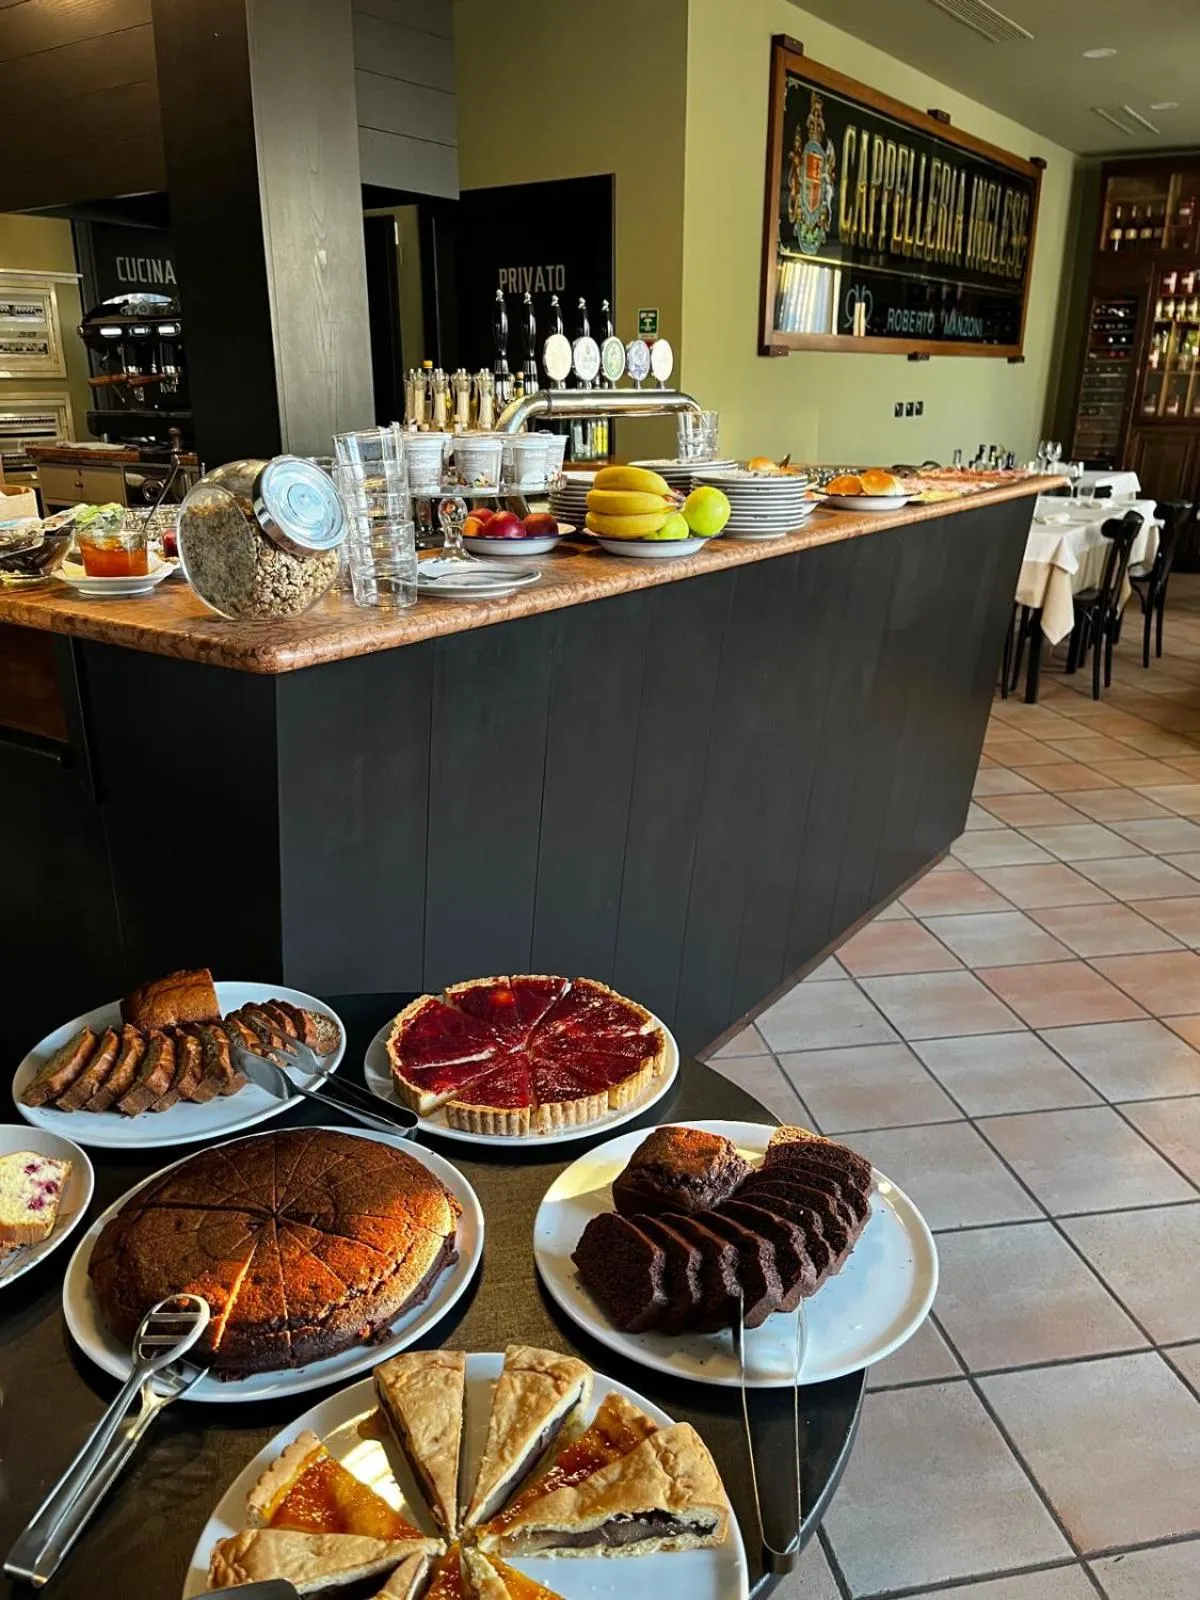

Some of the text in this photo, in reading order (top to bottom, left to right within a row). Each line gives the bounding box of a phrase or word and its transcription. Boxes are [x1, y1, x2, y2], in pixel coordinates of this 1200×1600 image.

[839, 124, 1029, 270] CAPPELLERIA INGLESE
[115, 256, 177, 284] CUCINA
[498, 264, 566, 293] PRIVATO
[886, 307, 984, 337] ROBERTO MANZONI
